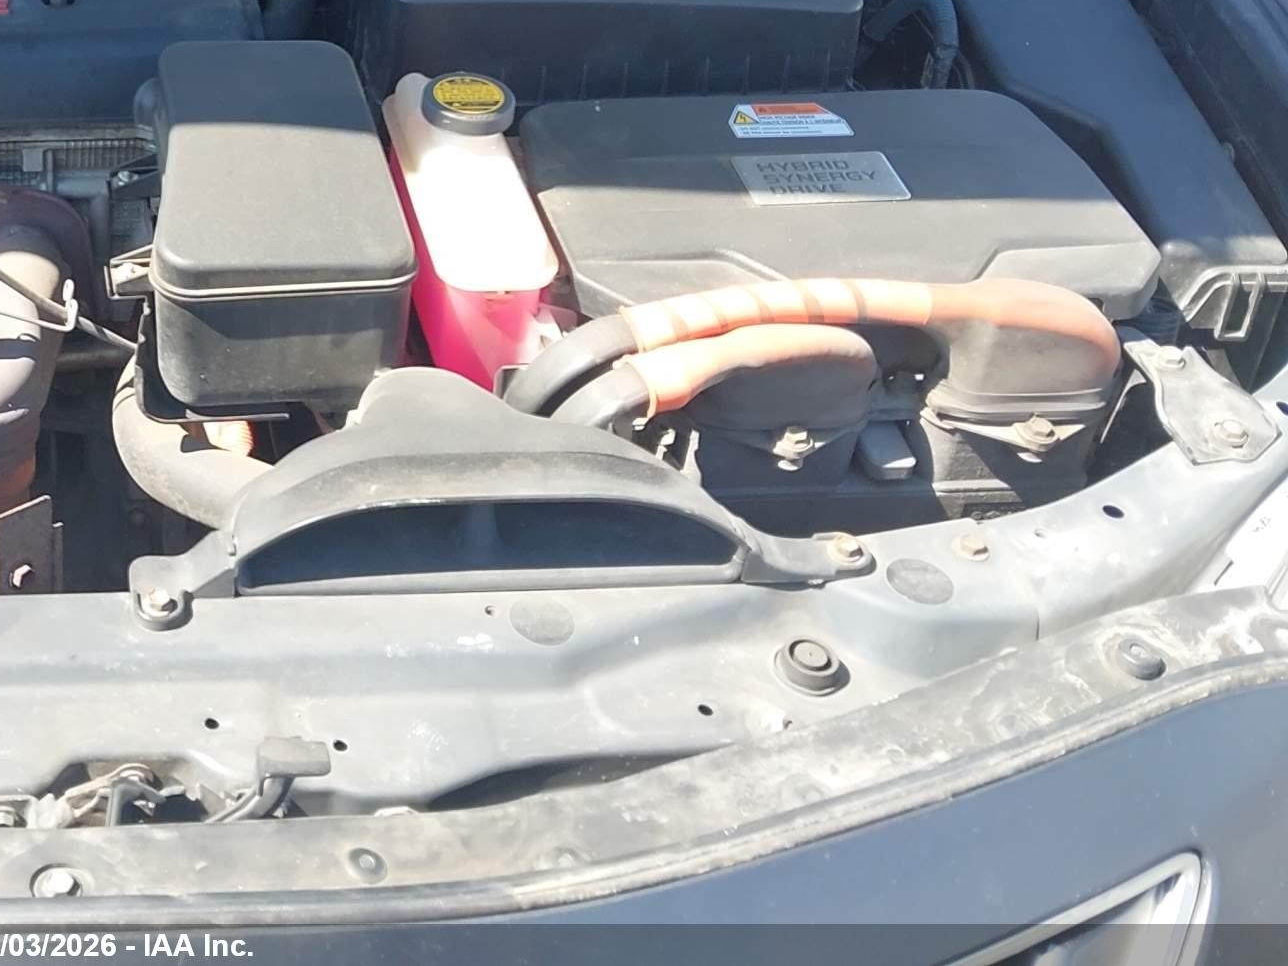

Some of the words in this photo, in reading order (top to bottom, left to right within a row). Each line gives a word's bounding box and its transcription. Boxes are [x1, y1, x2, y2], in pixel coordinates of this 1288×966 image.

[756, 160, 849, 172] HYBRID
[763, 170, 877, 184] SYNERGY
[769, 183, 847, 195] DRIVE
